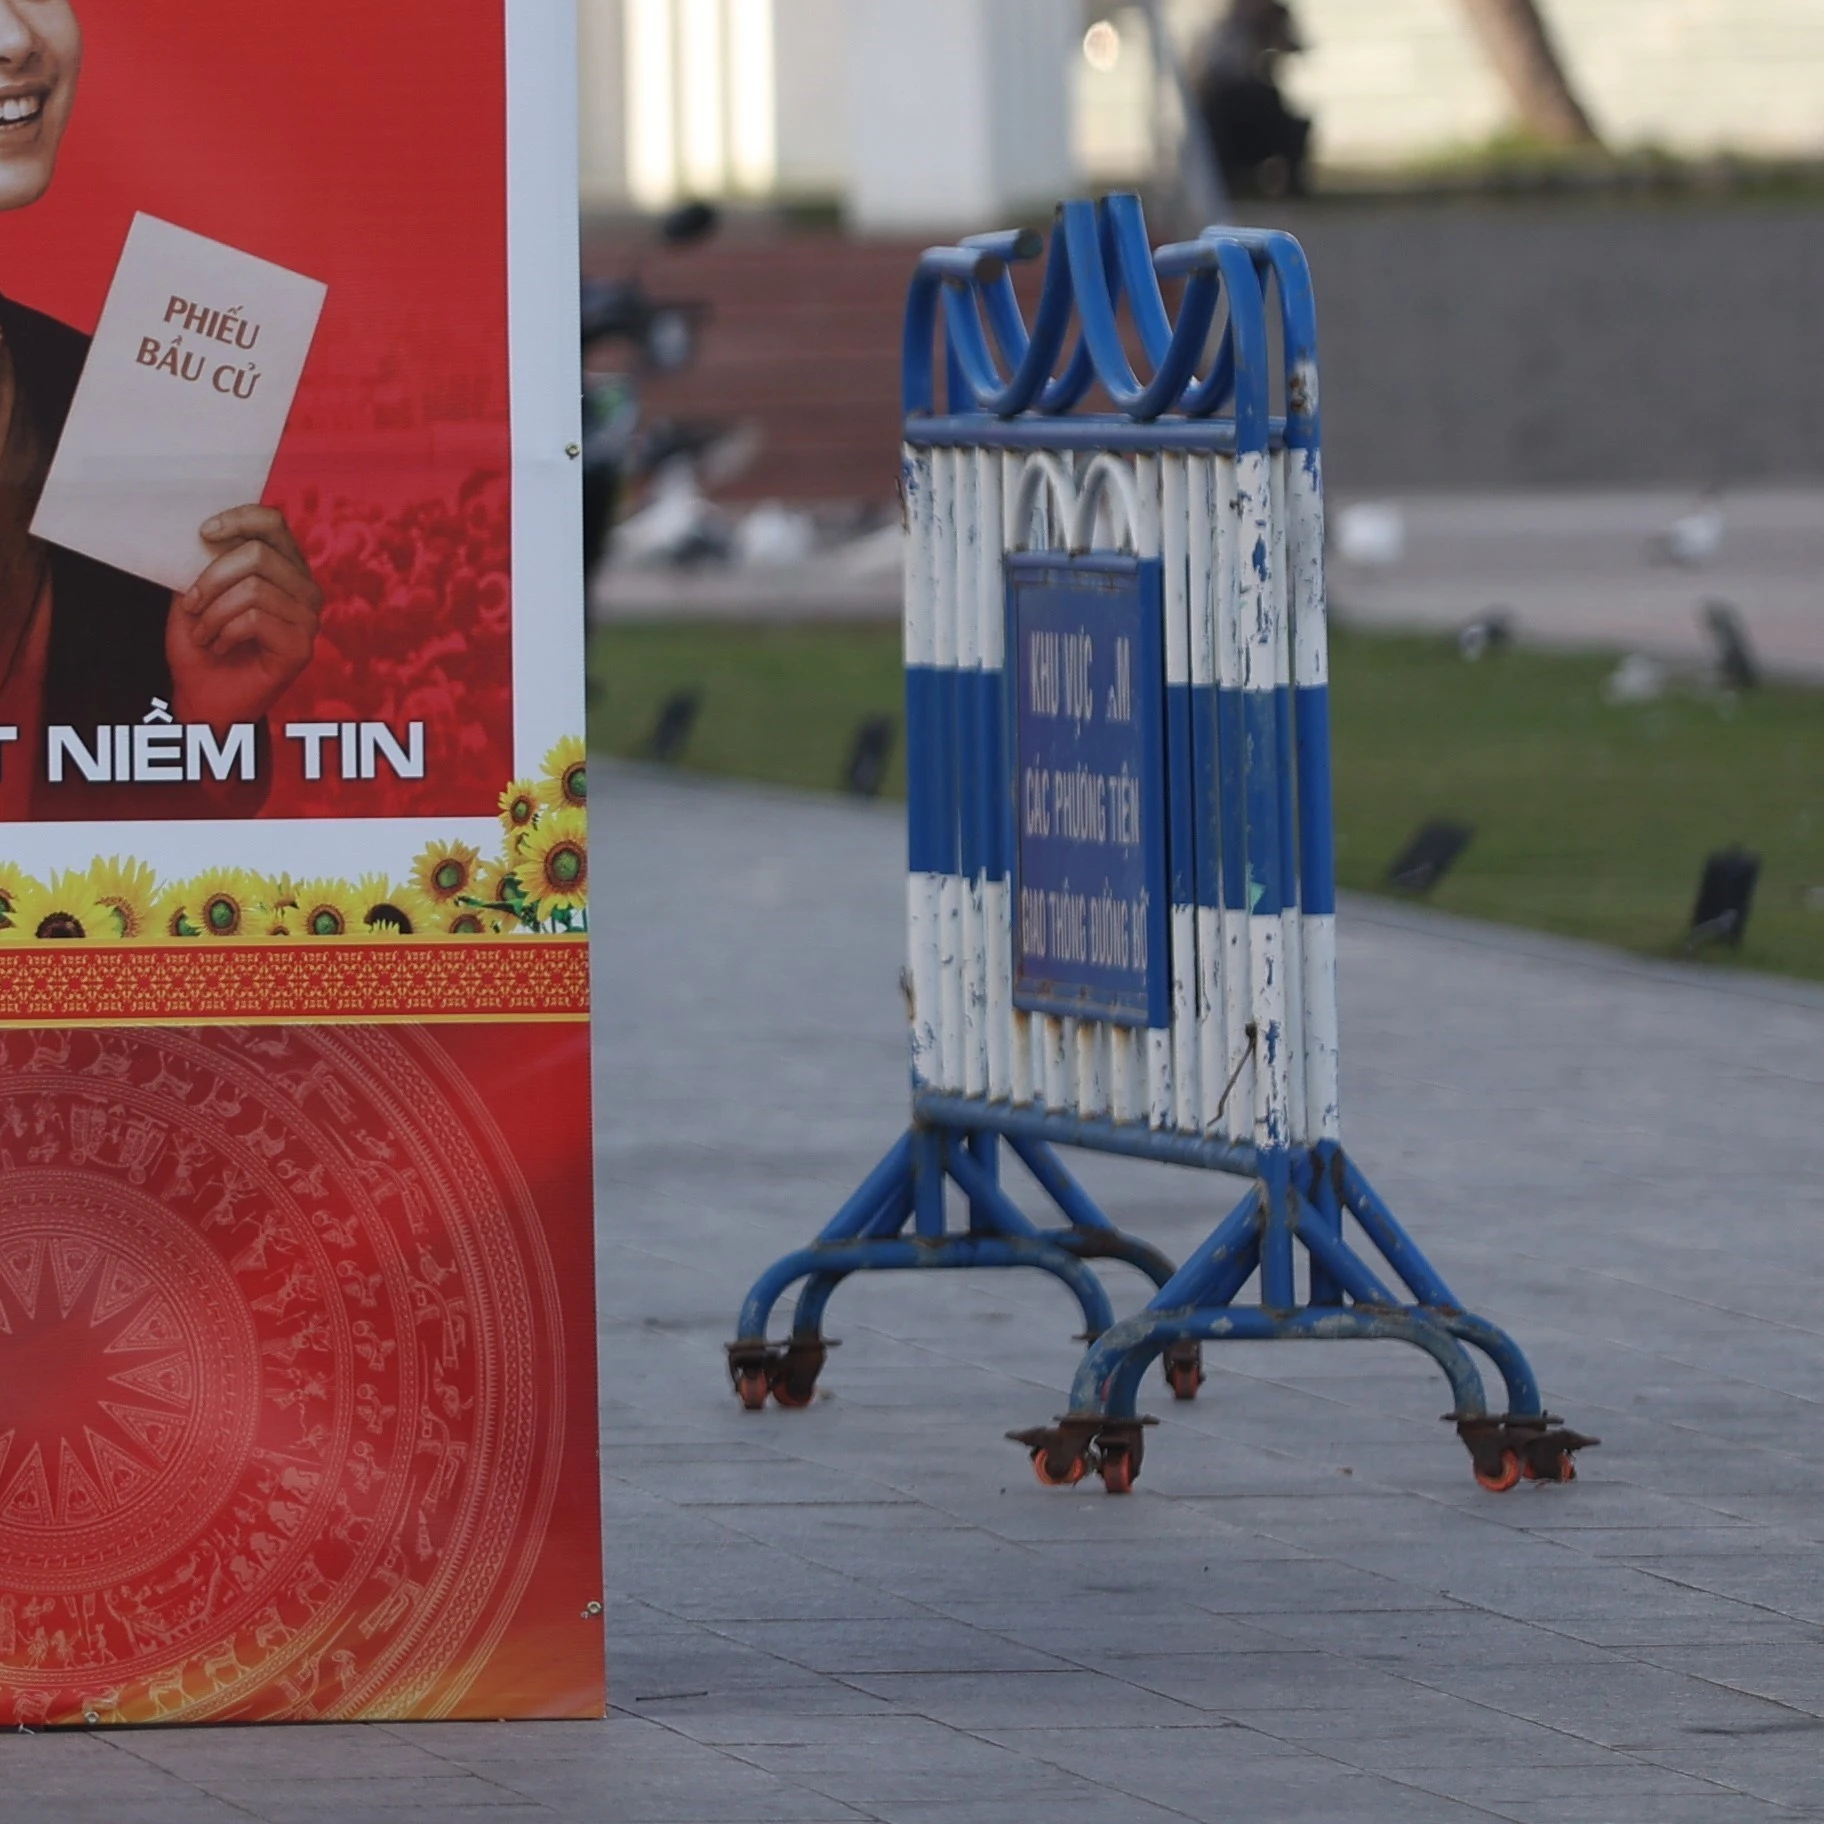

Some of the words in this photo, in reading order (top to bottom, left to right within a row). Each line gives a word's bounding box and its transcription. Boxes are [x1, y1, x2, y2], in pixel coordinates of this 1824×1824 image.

[163, 295, 260, 350] PHIẾU
[136, 335, 206, 382] BẦU
[212, 361, 262, 399] CỬ
[1031, 631, 1059, 717] KHU
[48, 697, 255, 782] NIỀM
[285, 721, 425, 779] TIN
[1026, 754, 1050, 838] CÁC
[1021, 885, 1047, 958] GIAO
[1049, 876, 1087, 962] THÔNG
